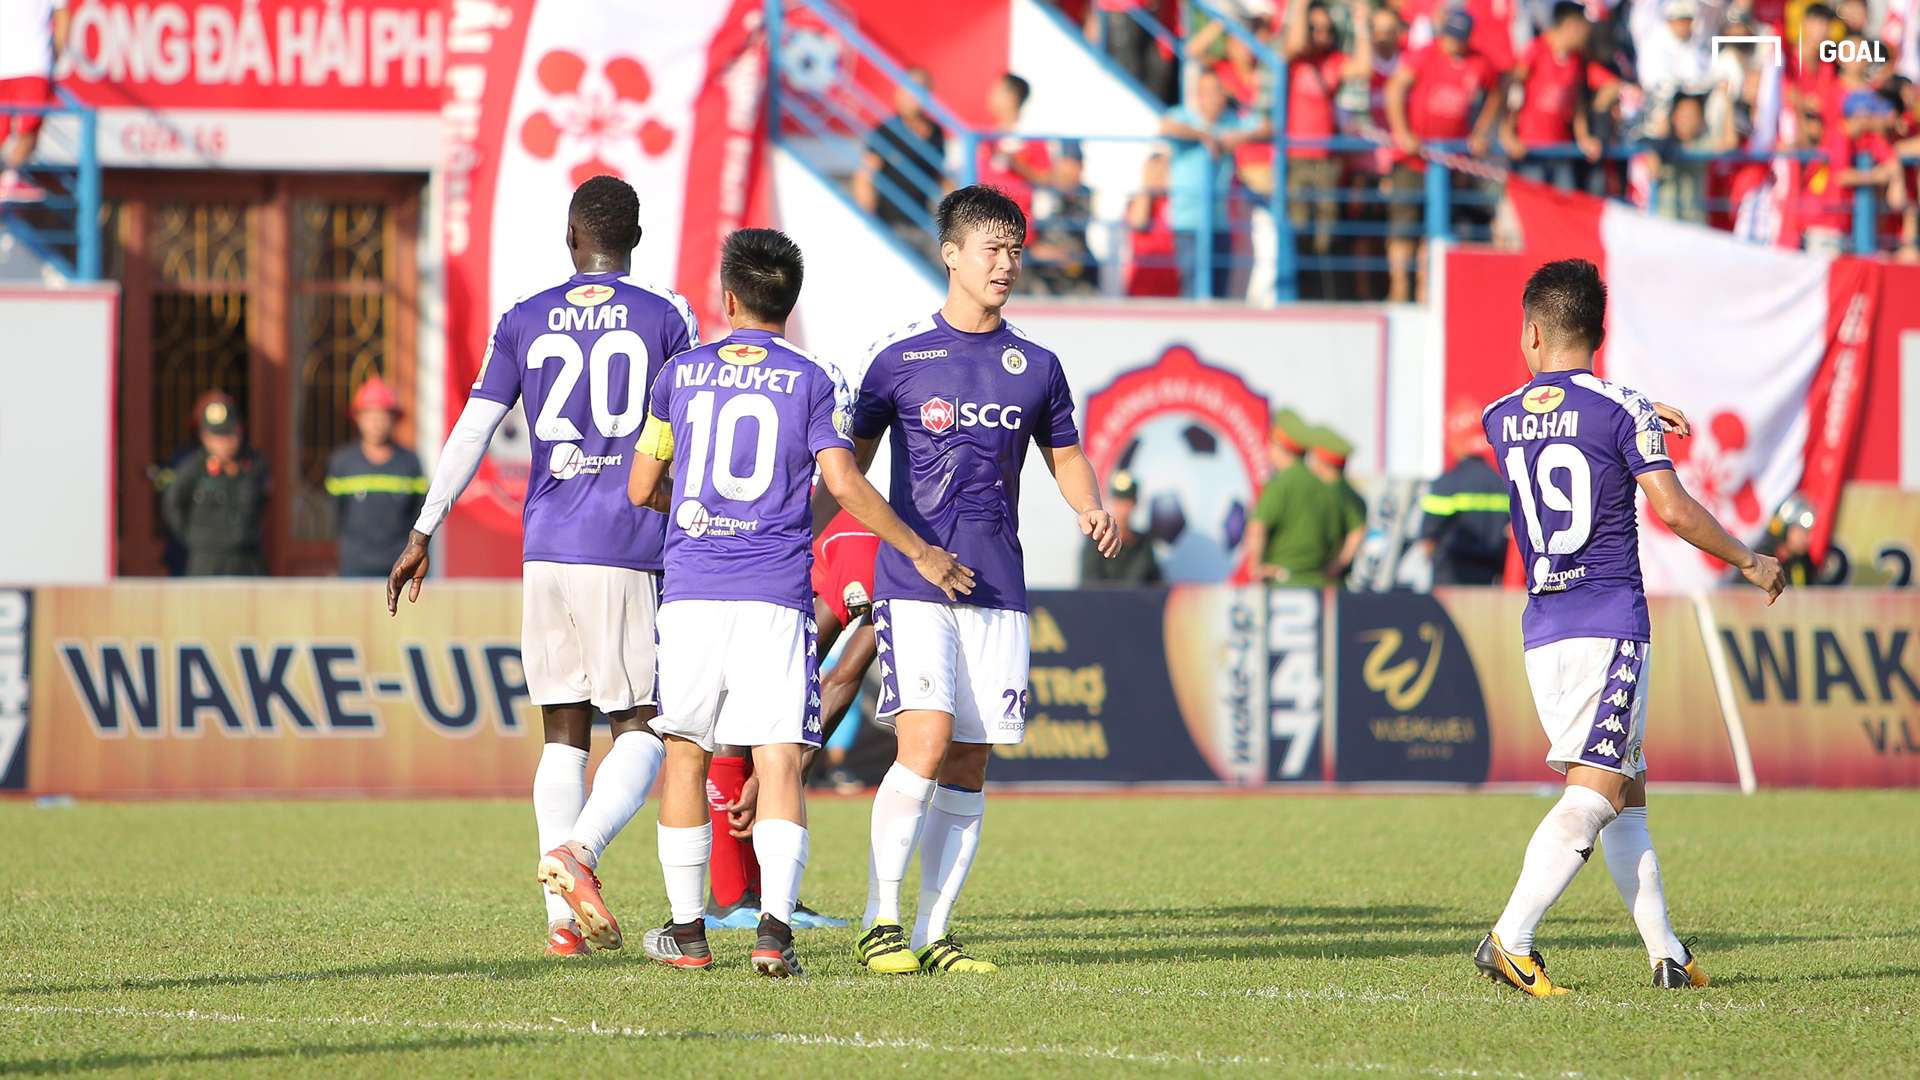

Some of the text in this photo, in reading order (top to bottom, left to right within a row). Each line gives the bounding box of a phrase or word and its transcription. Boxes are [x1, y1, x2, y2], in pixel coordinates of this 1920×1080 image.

[548, 305, 628, 331] OMAR
[526, 330, 649, 441] 20
[675, 362, 803, 395] N.V.QUYET
[960, 402, 1022, 430] SCG
[1502, 410, 1579, 443] N.Q.HAI
[683, 390, 779, 502] 10
[1504, 443, 1592, 555] 19
